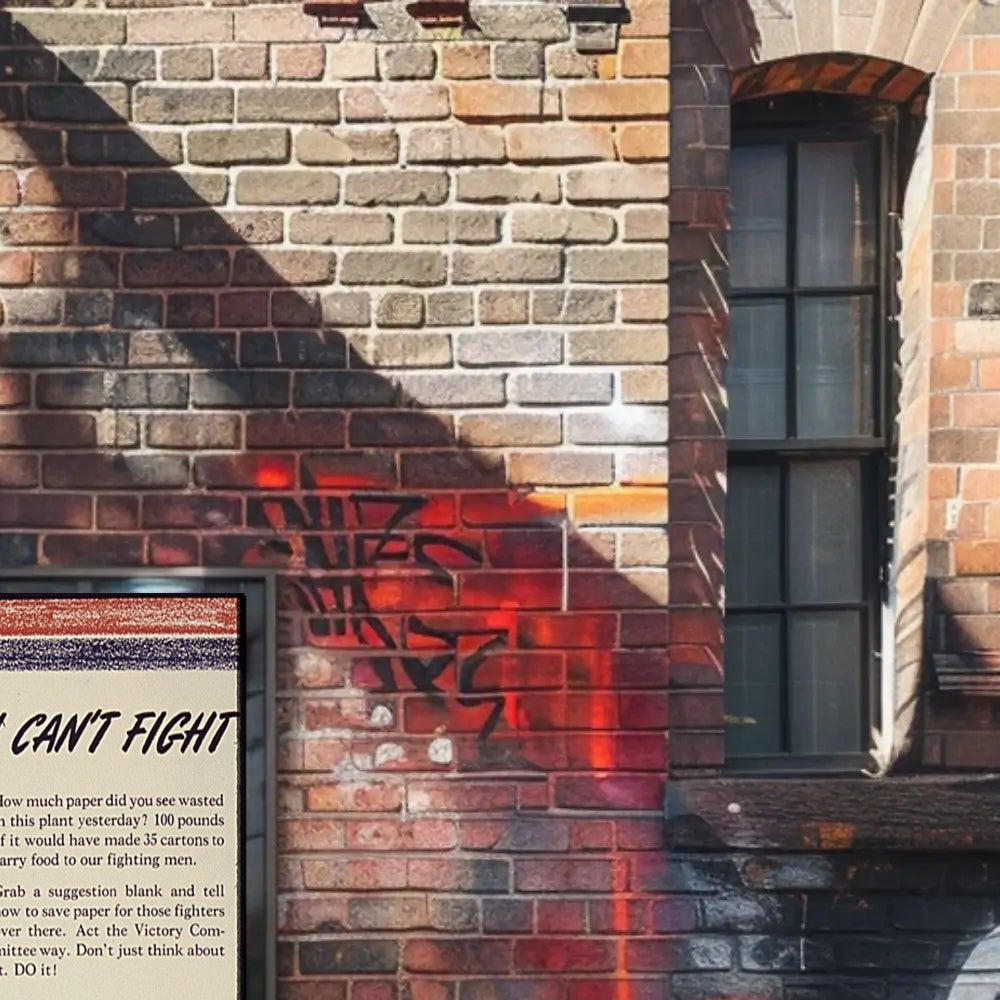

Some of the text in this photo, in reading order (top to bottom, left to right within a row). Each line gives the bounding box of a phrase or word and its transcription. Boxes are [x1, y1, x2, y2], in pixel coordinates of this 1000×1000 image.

[10, 708, 122, 755] CAN'T
[121, 710, 240, 755] FIGHT
[26, 794, 64, 808] much
[65, 796, 104, 811] paper
[105, 793, 127, 807] did
[129, 796, 154, 810] you
[155, 796, 176, 807] see
[178, 793, 224, 807] wasted
[10, 813, 35, 828] this
[38, 813, 74, 830] plant
[78, 813, 148, 830] yesterday?
[154, 813, 175, 827] 100
[177, 813, 225, 830] pounds
[9, 833, 20, 847] it
[24, 833, 65, 847] would
[69, 833, 101, 847] have
[104, 832, 141, 847] made
[143, 832, 158, 846] 35
[160, 835, 210, 847] cartons
[212, 835, 225, 847] to
[31, 852, 60, 867] food
[63, 855, 77, 867] to
[79, 856, 104, 866] our
[107, 852, 161, 869] fighting
[164, 856, 197, 866] men.
[33, 888, 41, 898] a
[48, 884, 117, 901] suggestion
[125, 884, 163, 898] blank
[170, 883, 195, 898] and
[203, 884, 225, 898] tell
[25, 907, 39, 918] to
[41, 908, 71, 918] save
[73, 907, 111, 921] paper
[114, 903, 134, 917] for
[136, 903, 171, 918] those
[174, 903, 226, 920] fighters
[28, 923, 66, 937] there.
[75, 924, 100, 937] Act
[106, 923, 128, 937] the
[134, 922, 183, 940] Victory
[189, 922, 225, 937] Com-
[39, 947, 71, 960] way.
[76, 942, 114, 957] Don't
[116, 943, 143, 960] just
[147, 943, 184, 957] think
[187, 943, 225, 957] about
[14, 962, 37, 977] DO
[41, 963, 57, 977] it!
